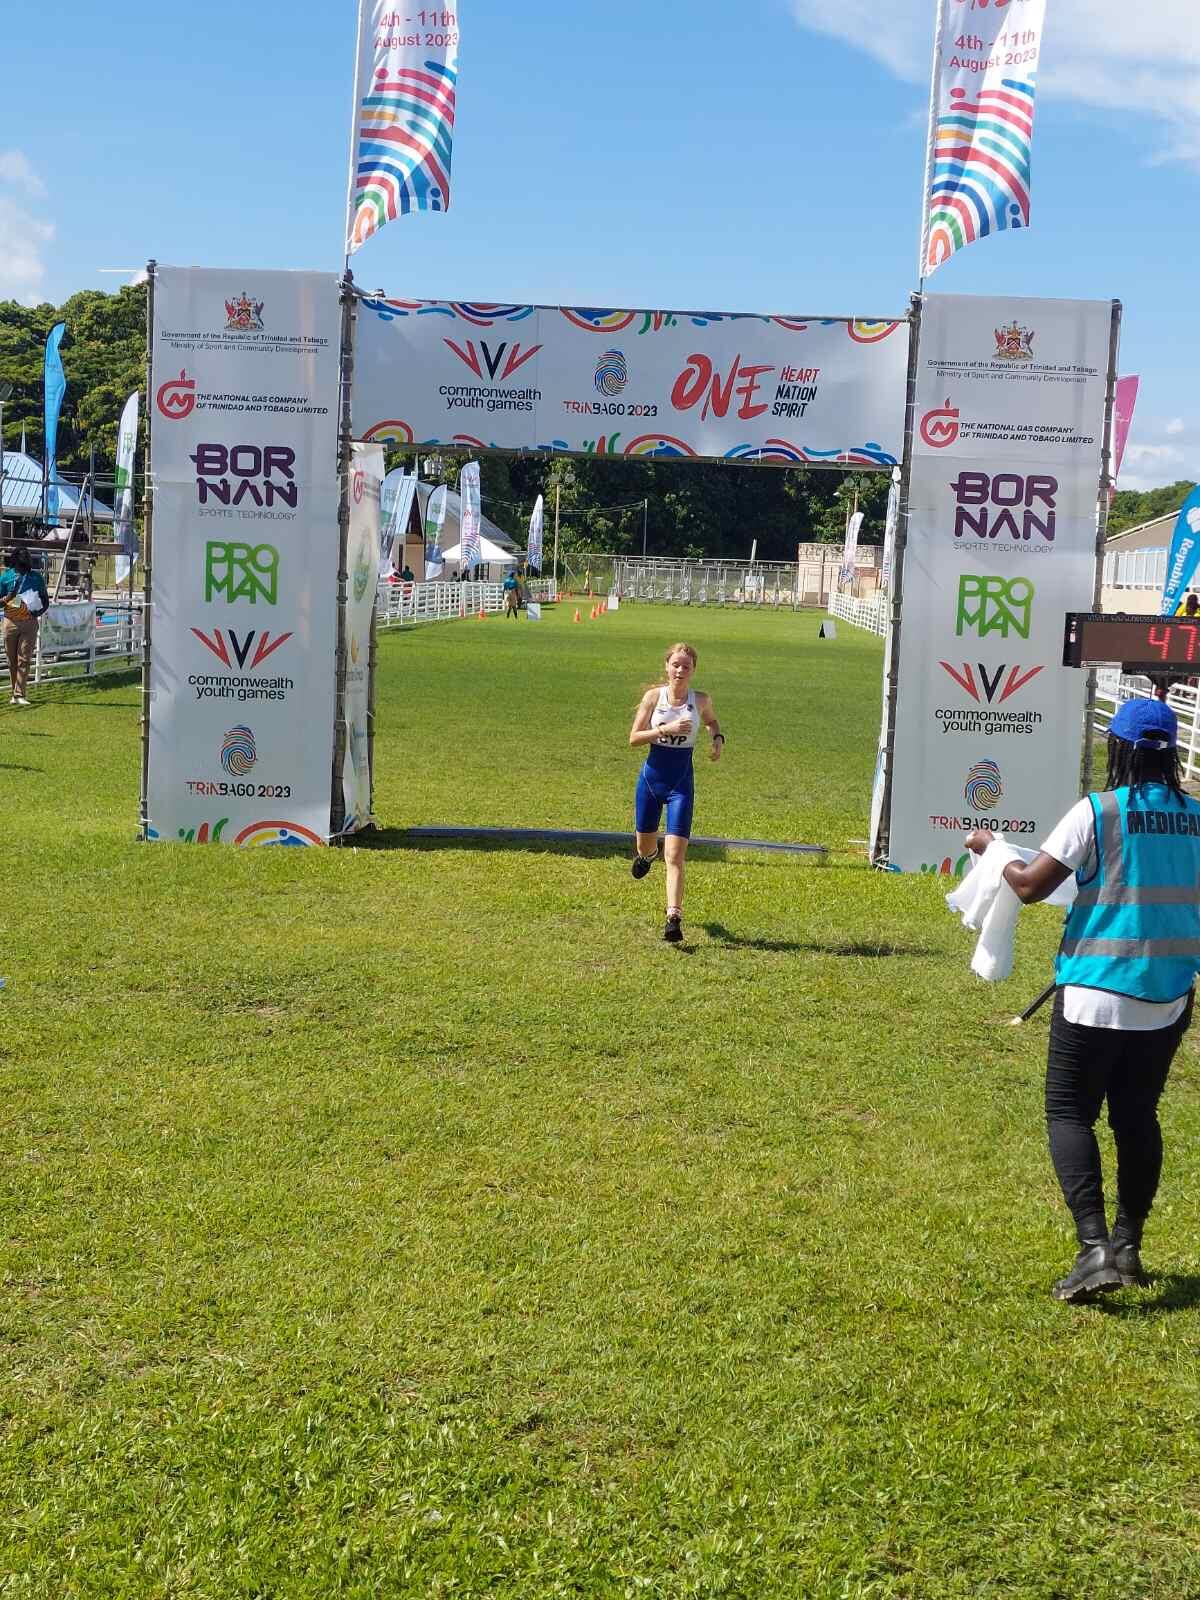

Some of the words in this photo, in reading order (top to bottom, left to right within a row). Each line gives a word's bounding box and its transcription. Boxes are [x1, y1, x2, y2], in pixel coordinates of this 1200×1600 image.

[380, 11, 400, 29] 4th
[418, 9, 456, 27] 11th
[374, 32, 422, 50] August
[425, 33, 458, 47] 2023
[954, 34, 983, 51] 4th
[1000, 29, 1036, 47] 11th
[950, 55, 1001, 73] August
[1004, 47, 1038, 65] 2023
[161, 330, 201, 338] Government
[261, 334, 288, 342] Trinidad
[928, 360, 968, 368] Government
[991, 362, 1019, 370] Republic
[1029, 363, 1057, 371] Trinidad
[936, 370, 962, 379] Ministry
[439, 385, 542, 401] commonwealth
[671, 353, 775, 422] ONE
[780, 365, 820, 384] HEART
[775, 384, 818, 402] NATION
[196, 393, 211, 401] THE
[212, 394, 250, 402] NATIONAL
[251, 395, 268, 403] GAS
[268, 396, 309, 404] COMPANY
[446, 396, 484, 410] youth
[486, 399, 534, 412] games
[196, 402, 208, 410] OF
[208, 403, 244, 411] TRINIDAD
[245, 404, 262, 412] AND
[263, 405, 296, 413] TOBAGO
[297, 406, 329, 414] LIMITED
[627, 404, 658, 417] 2023
[960, 422, 976, 430] THE
[977, 422, 1016, 431] NATIONAL
[1017, 424, 1034, 432] GAS
[1034, 425, 1074, 434] COMPANY
[972, 432, 1009, 440] TRINIDAD
[1010, 433, 1027, 441] AND
[1028, 434, 1060, 443] TOBAGO
[1061, 435, 1095, 444] LIMITED
[190, 443, 296, 479] BOR
[950, 472, 1059, 508] BOR
[199, 508, 233, 518] SPORTS
[237, 510, 297, 521] TECHNOLOGY
[954, 506, 1056, 541] NAN
[953, 541, 989, 551] SPORTS
[992, 542, 1053, 553] TECHNOLOGY
[1166, 538, 1194, 595] Republic
[188, 675, 294, 689] commonwealth
[196, 686, 235, 700] youth
[237, 687, 286, 701] games
[935, 709, 1042, 723] commonwealth
[942, 719, 982, 734] youth
[984, 721, 1034, 736] games
[659, 734, 687, 746] CYP
[258, 784, 291, 799] 2023
[1001, 819, 1036, 833] 2023
